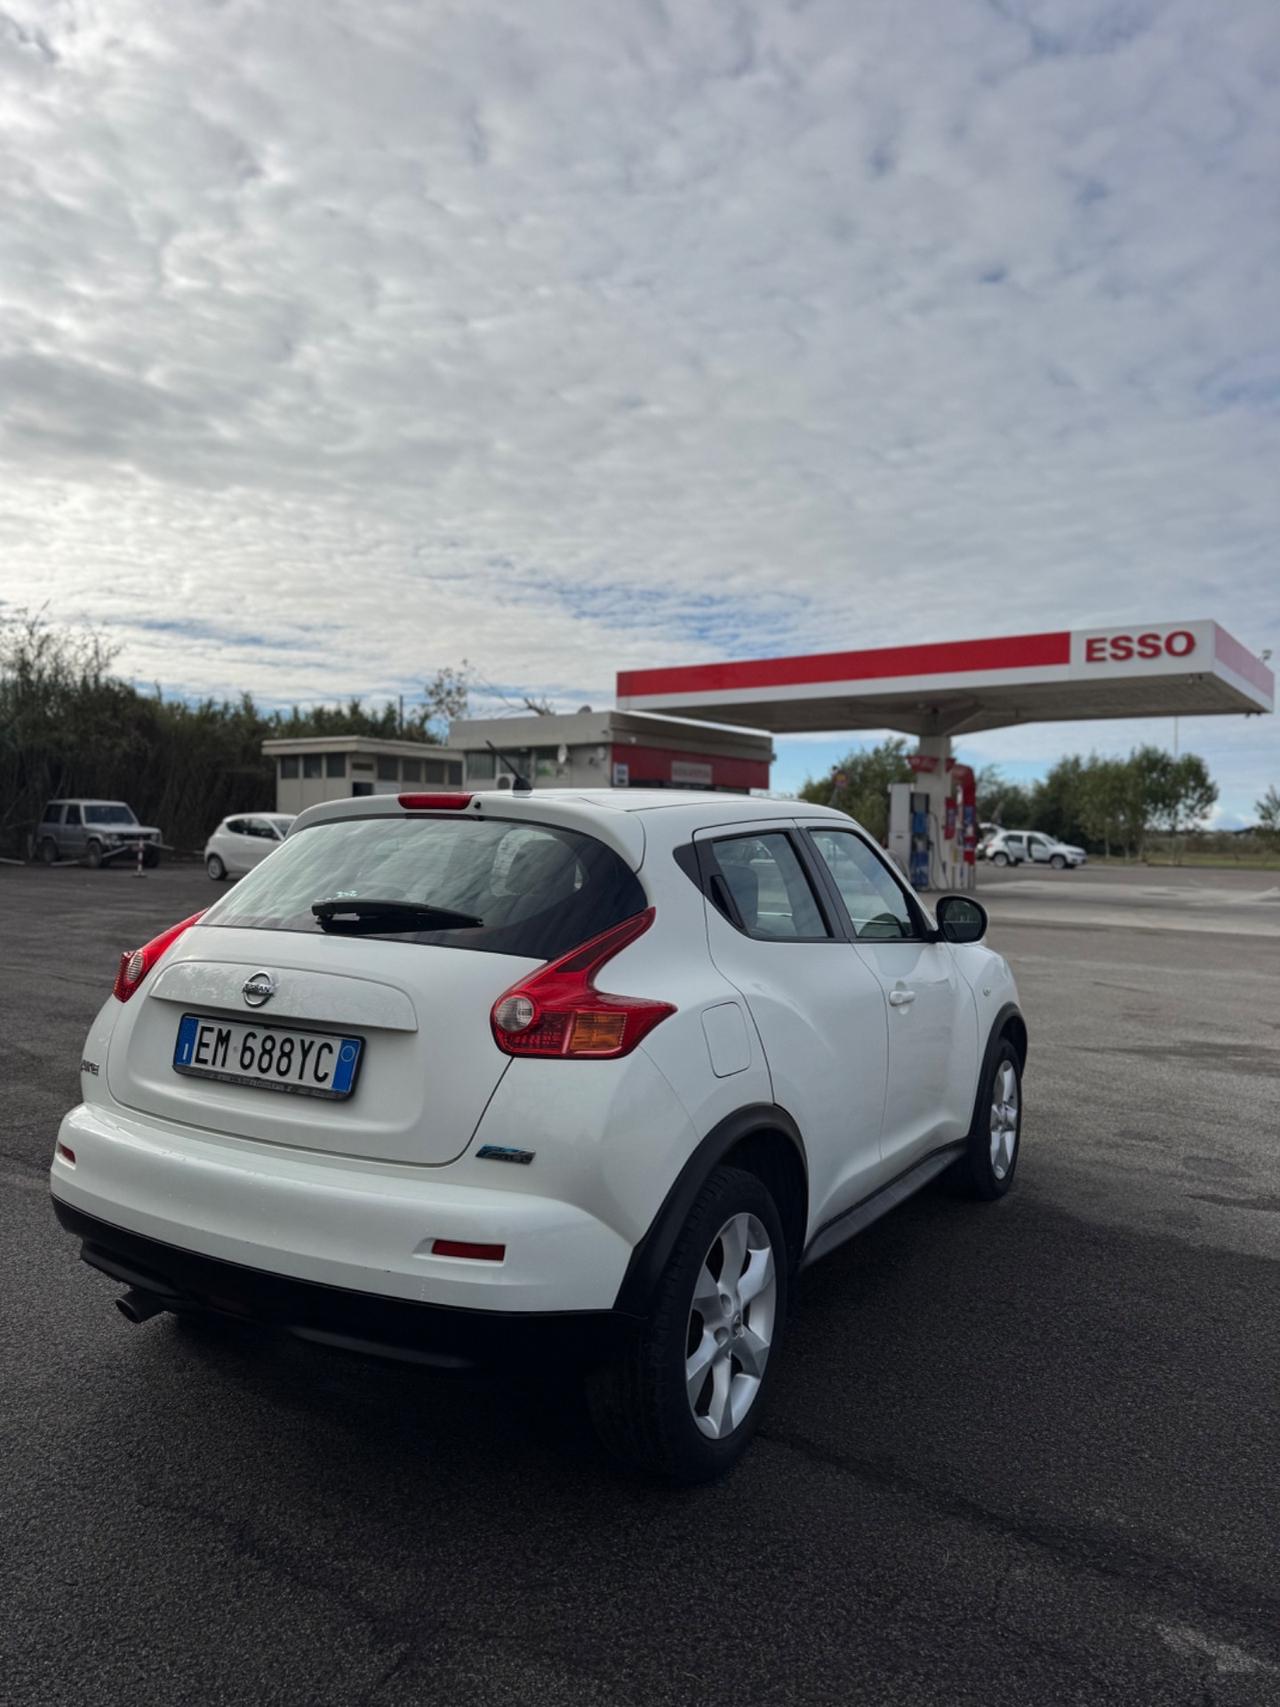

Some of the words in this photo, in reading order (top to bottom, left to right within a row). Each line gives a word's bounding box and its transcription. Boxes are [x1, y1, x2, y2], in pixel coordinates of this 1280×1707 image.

[1085, 630, 1196, 662] ESSO
[195, 1026, 231, 1067] EM
[239, 1031, 333, 1083] 688YC
